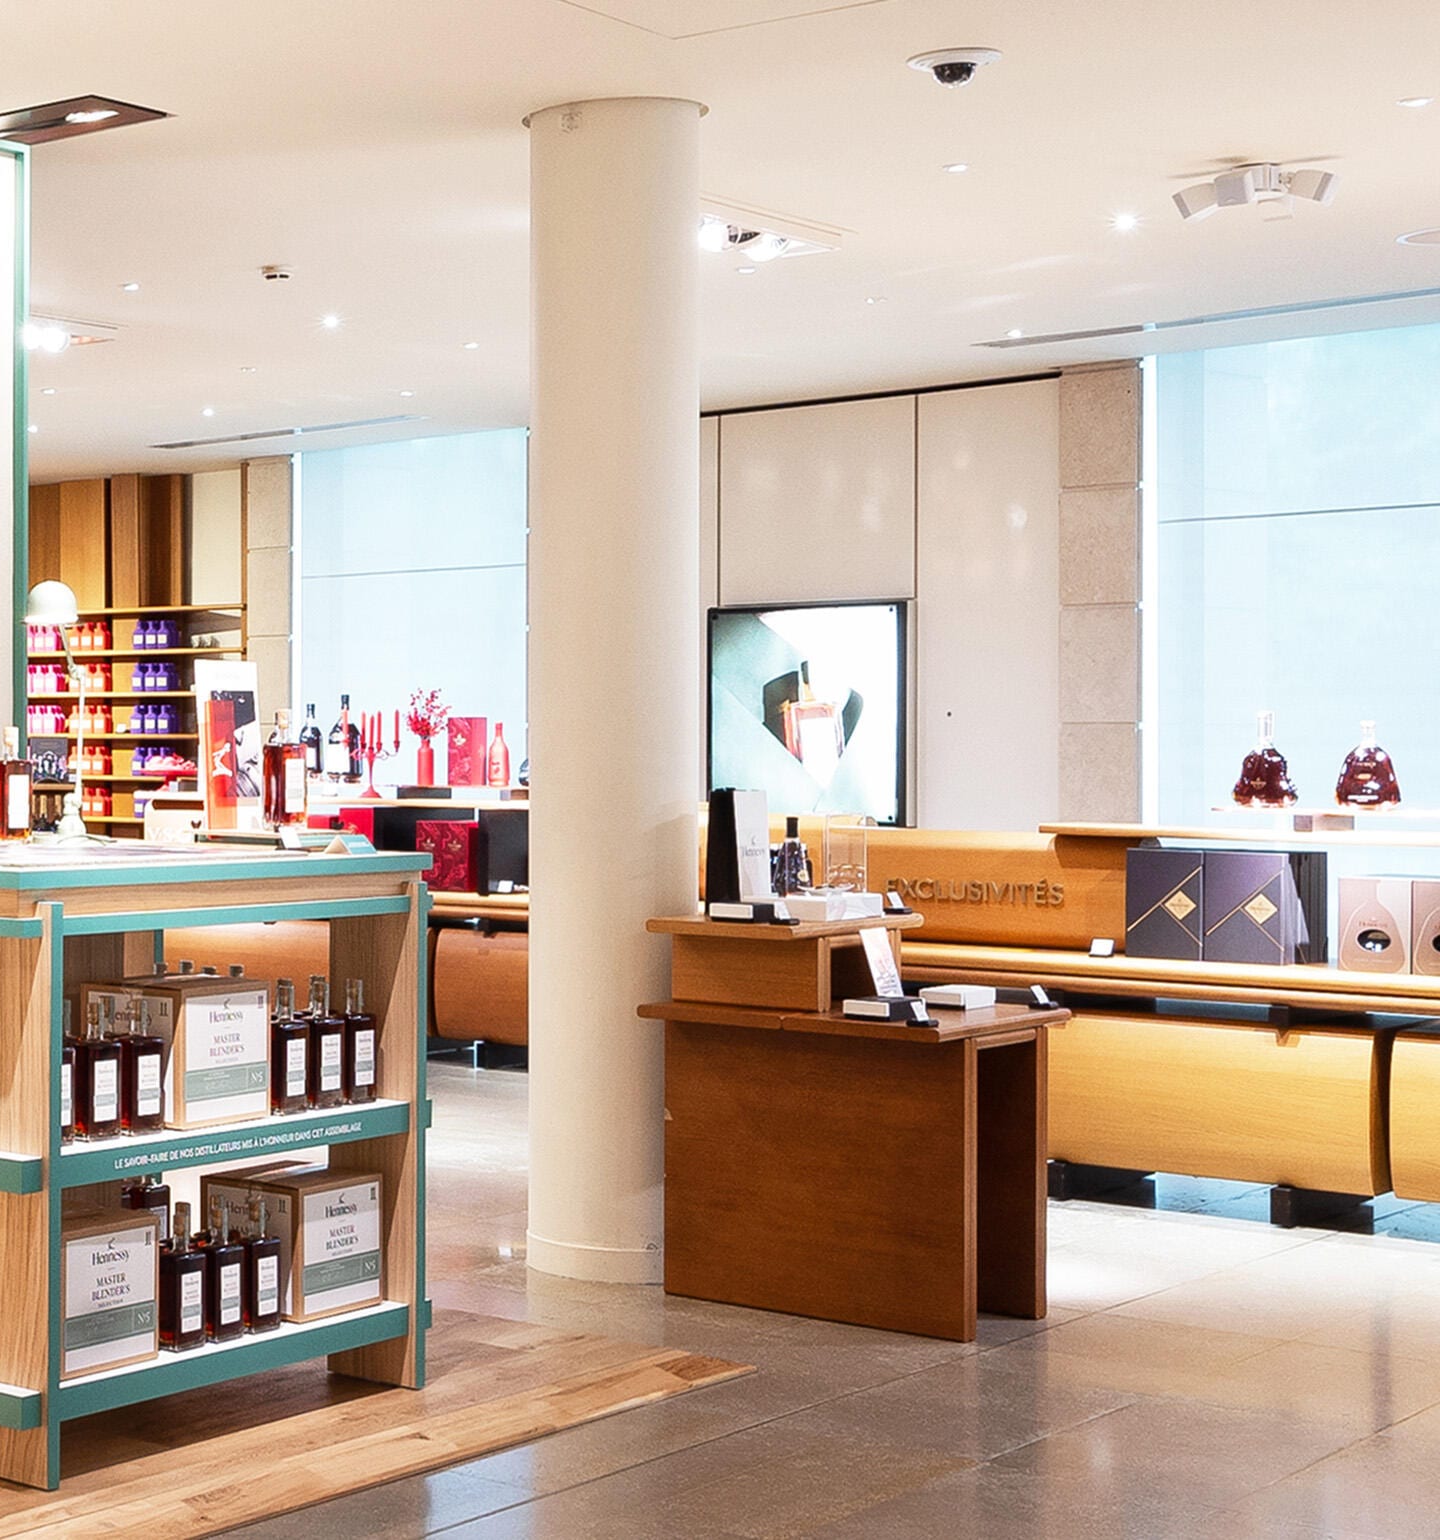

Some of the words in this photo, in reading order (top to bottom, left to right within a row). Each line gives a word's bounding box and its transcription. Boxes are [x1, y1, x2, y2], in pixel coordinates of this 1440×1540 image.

[886, 878, 1065, 905] EXCLUSIVITÉS
[114, 1159, 123, 1169] LE
[124, 1151, 169, 1167] SAVOIR-FAIRE
[169, 1149, 179, 1160] DE
[180, 1147, 194, 1158] NOS
[195, 1140, 241, 1156] DISTILLATEURS
[92, 1250, 130, 1266] Hennessy
[96, 1272, 127, 1287] MASTER
